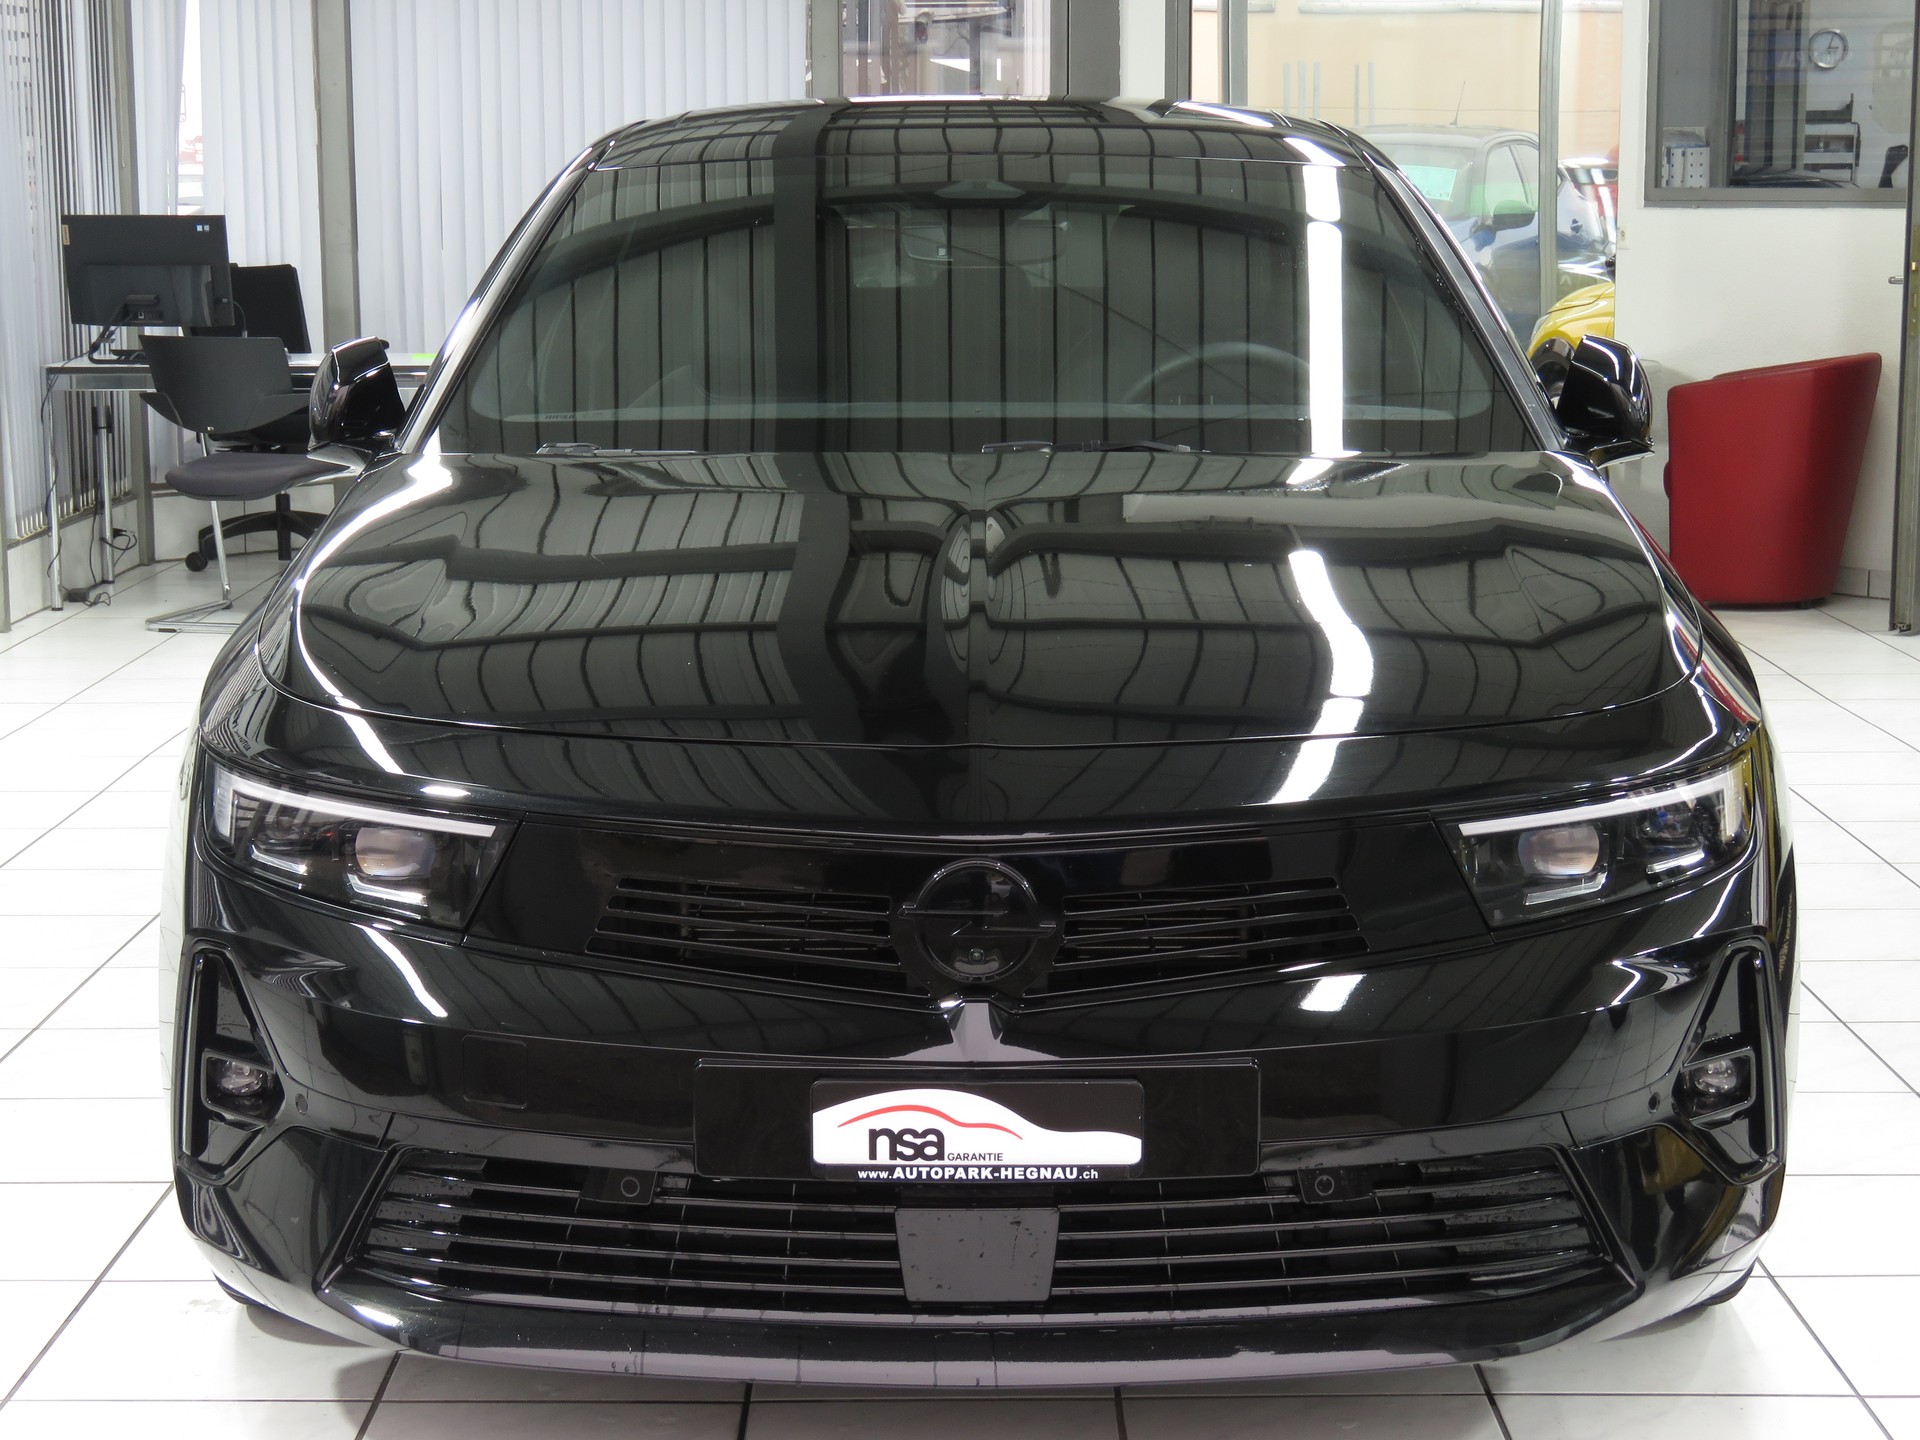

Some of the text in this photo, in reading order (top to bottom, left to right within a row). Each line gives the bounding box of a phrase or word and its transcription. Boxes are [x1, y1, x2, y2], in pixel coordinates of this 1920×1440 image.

[868, 1127, 1003, 1162] nsa GARANTIE
[858, 1166, 1099, 1180] www.AUTOPARK-HEGNAU.ch
